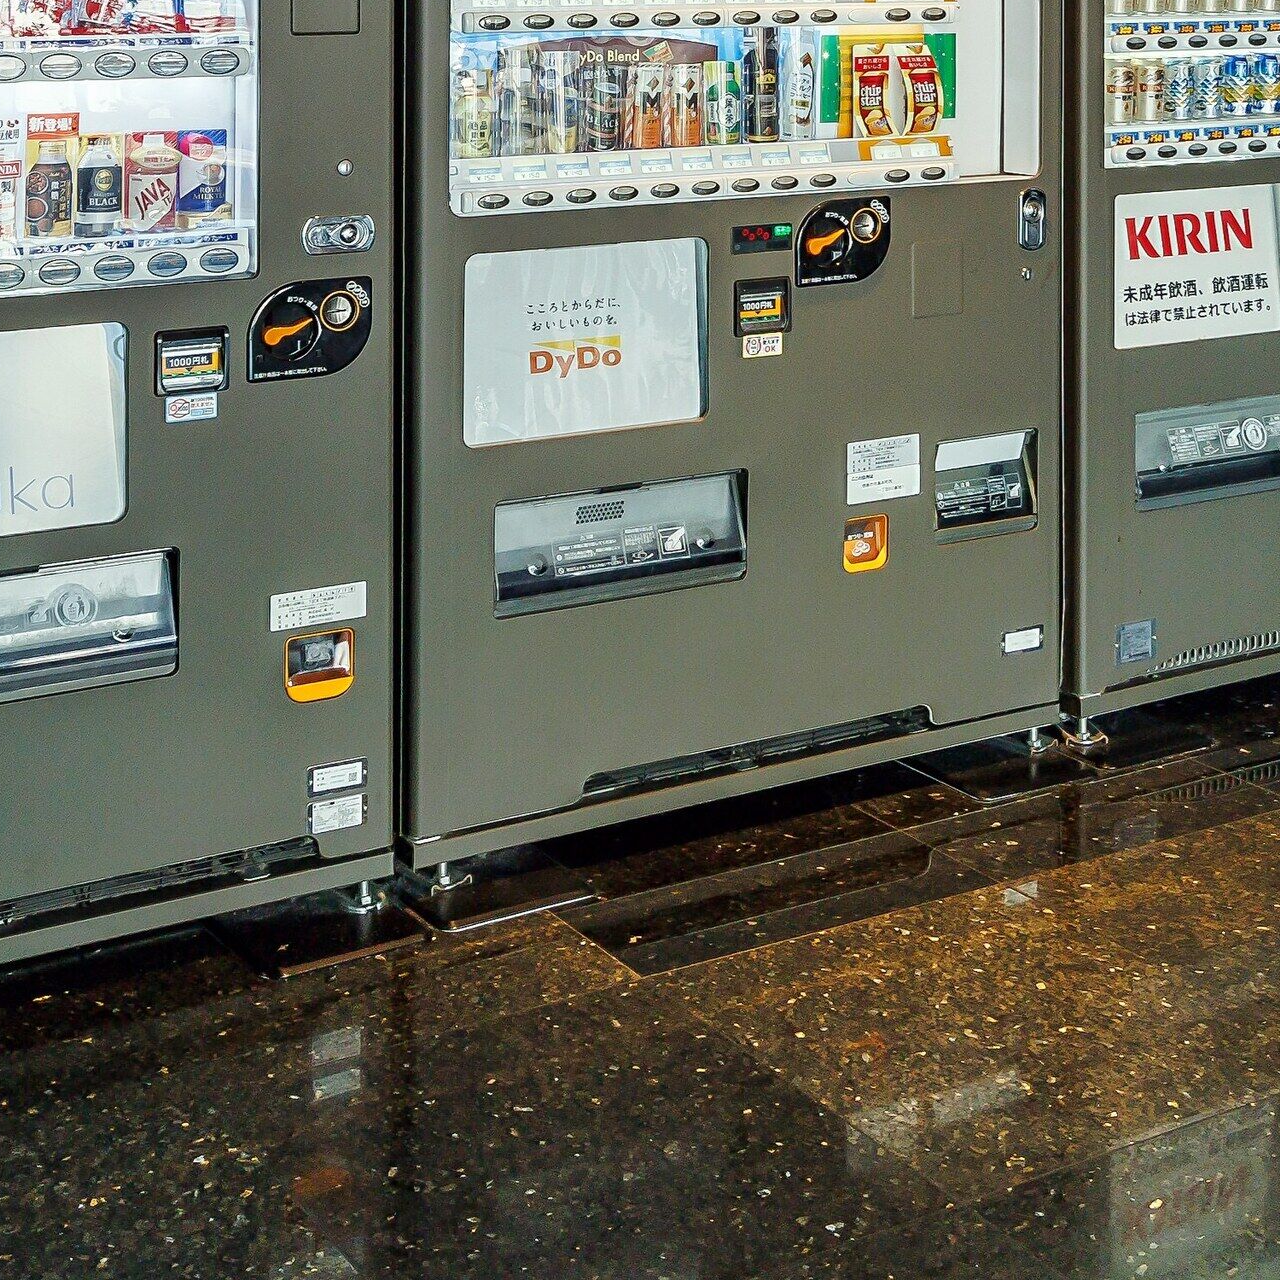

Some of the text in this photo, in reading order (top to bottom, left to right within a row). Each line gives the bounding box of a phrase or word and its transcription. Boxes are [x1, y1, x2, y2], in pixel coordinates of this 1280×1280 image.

[607, 48, 640, 62] Blend
[860, 86, 881, 97] chip
[913, 82, 935, 94] chip
[860, 94, 882, 106] star
[914, 91, 936, 103] star
[89, 196, 118, 207] BLACK
[135, 178, 170, 220] JAVA
[1125, 208, 1253, 261] KIRIN
[742, 300, 775, 310] 1000円札
[1125, 298, 1272, 326] は法律で禁止されています。
[530, 314, 619, 332] おいしいものを。
[764, 344, 777, 353] OK
[168, 354, 211, 369] 1000円札
[529, 346, 622, 379] DyDo
